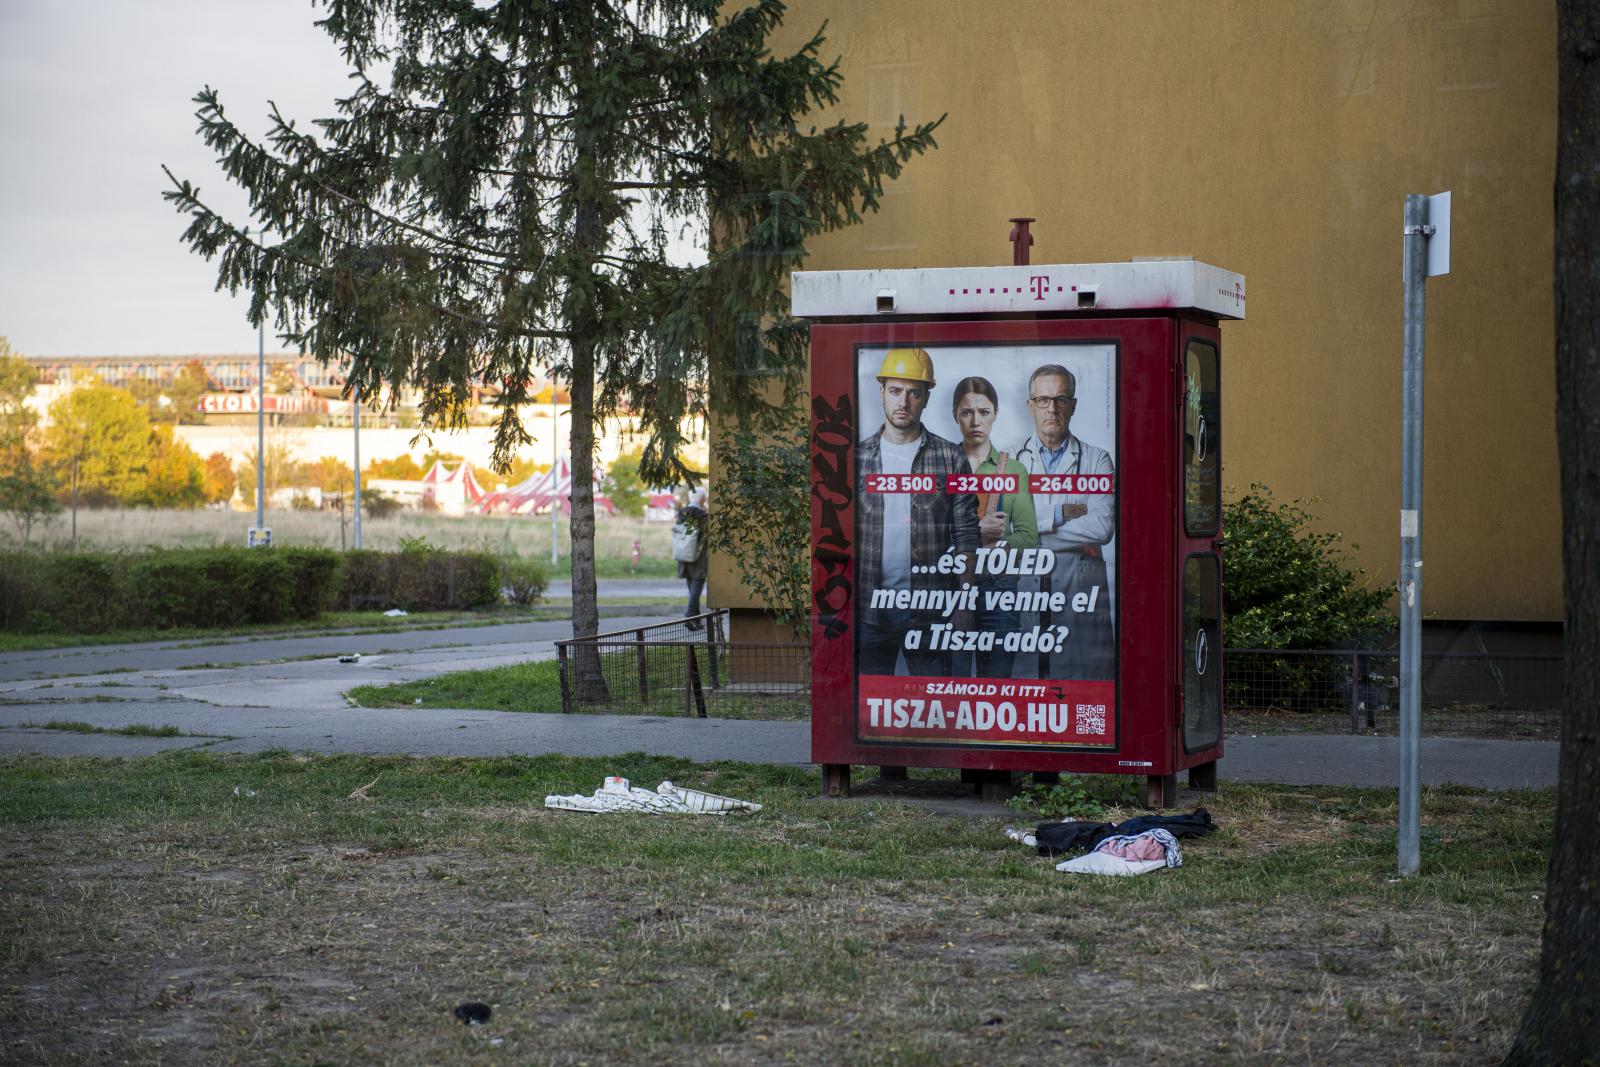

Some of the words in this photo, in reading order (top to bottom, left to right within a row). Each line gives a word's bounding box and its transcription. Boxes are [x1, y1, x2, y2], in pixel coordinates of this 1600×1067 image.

[198, 396, 262, 412] CTORY
[868, 476, 897, 491] -28
[901, 476, 933, 491] 500
[949, 476, 978, 491] -32
[982, 476, 1016, 492] 000
[1032, 476, 1073, 492] -264
[1076, 476, 1110, 492] 000
[911, 546, 968, 575] ...és
[974, 540, 1055, 575] TŐLED
[870, 582, 979, 617] mennyit
[985, 590, 1066, 612] venne
[1071, 585, 1100, 613] el
[904, 629, 923, 650] a
[929, 623, 1069, 654] Tisza-adó?
[926, 680, 997, 696] SZÁMOLD
[1001, 684, 1015, 697] KI
[1018, 685, 1046, 698] ITT!
[866, 698, 1069, 733] TISZA-ADO.HU
